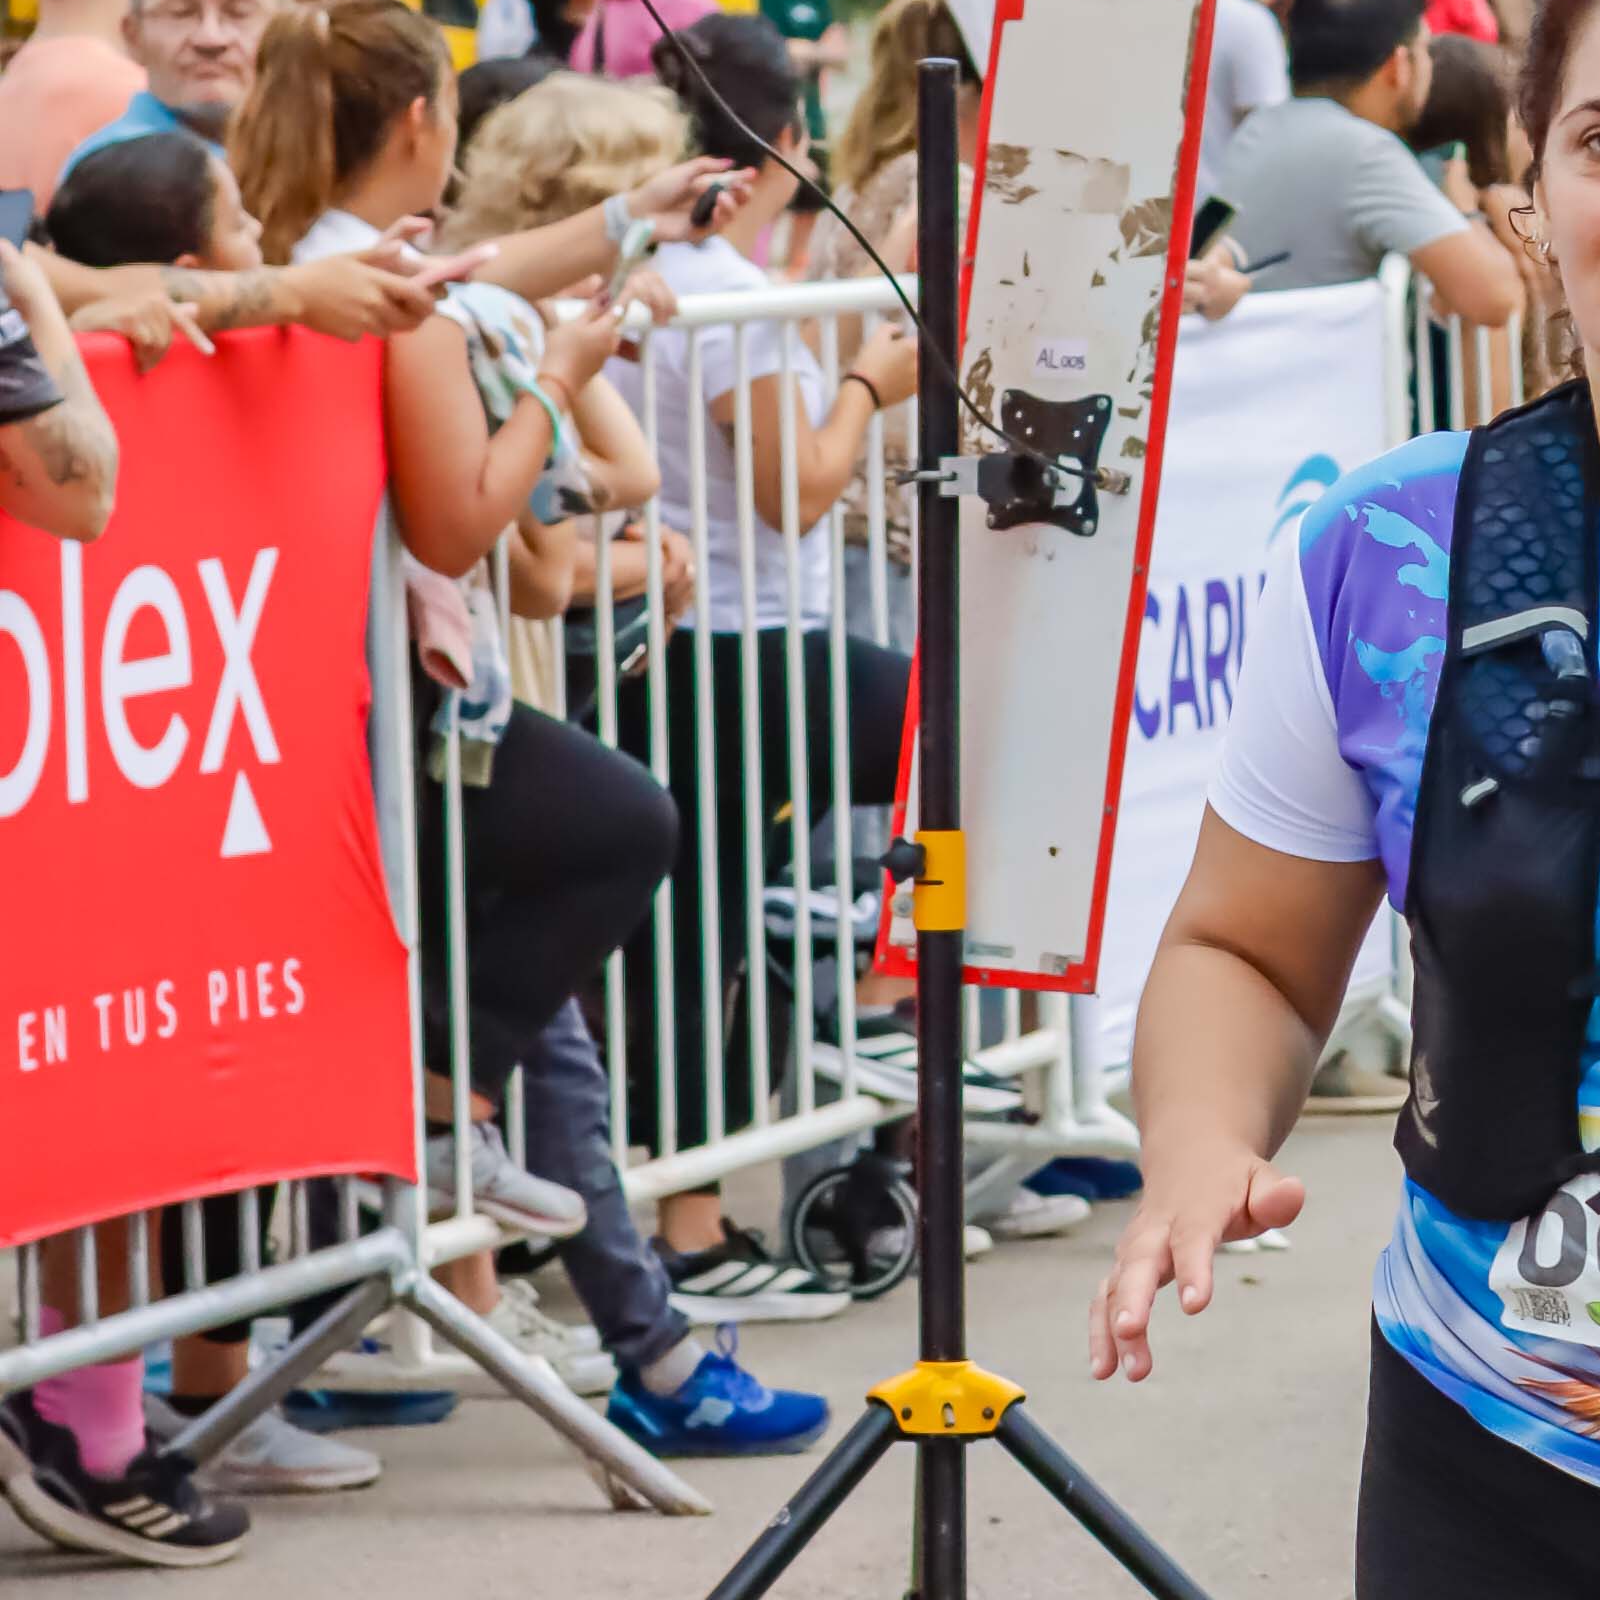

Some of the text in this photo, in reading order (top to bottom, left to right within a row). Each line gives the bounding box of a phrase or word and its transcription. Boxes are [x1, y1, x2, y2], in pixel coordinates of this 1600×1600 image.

[17, 957, 305, 1071] EN TUS PIES
